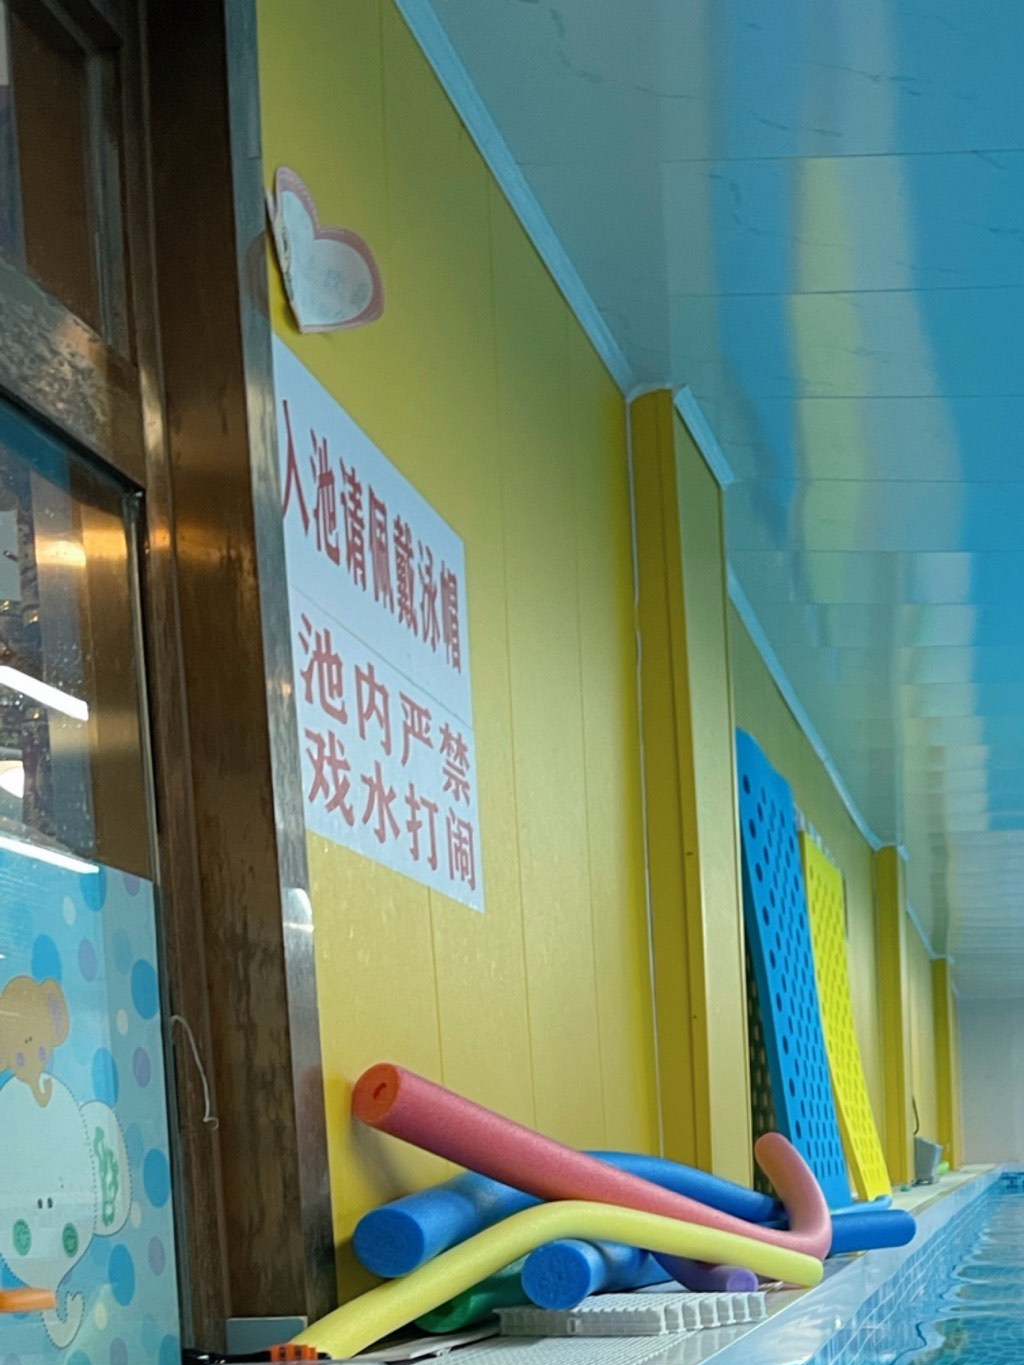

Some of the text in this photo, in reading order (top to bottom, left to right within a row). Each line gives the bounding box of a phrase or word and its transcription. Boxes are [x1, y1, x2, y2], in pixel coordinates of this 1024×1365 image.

[299, 612, 471, 808] 池内严禁
[305, 728, 476, 892] 戏水打闹
